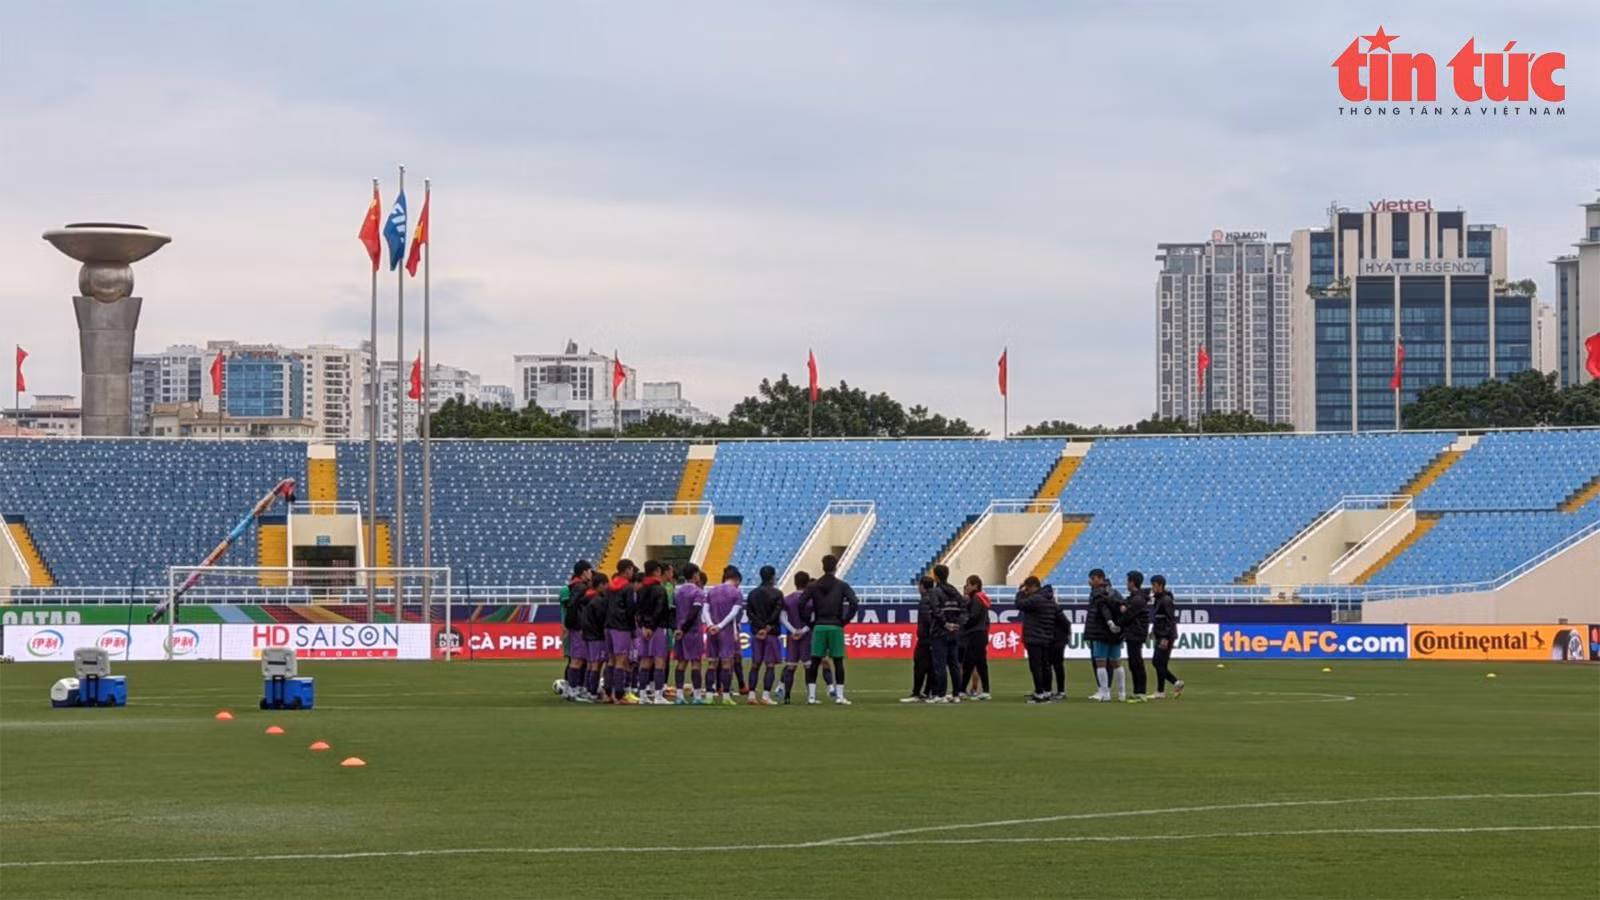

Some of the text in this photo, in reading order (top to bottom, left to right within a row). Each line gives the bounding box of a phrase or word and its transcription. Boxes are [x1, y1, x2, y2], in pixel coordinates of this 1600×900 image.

[1369, 199, 1433, 212] viettel
[1366, 262, 1480, 273] HYATT REGENCY
[253, 625, 399, 647] HD SAISON
[468, 632, 563, 650] CÀ PHÊ PH
[1222, 631, 1405, 653] the-AFC.com
[1414, 630, 1529, 655] Continental
[307, 649, 389, 657] inance
